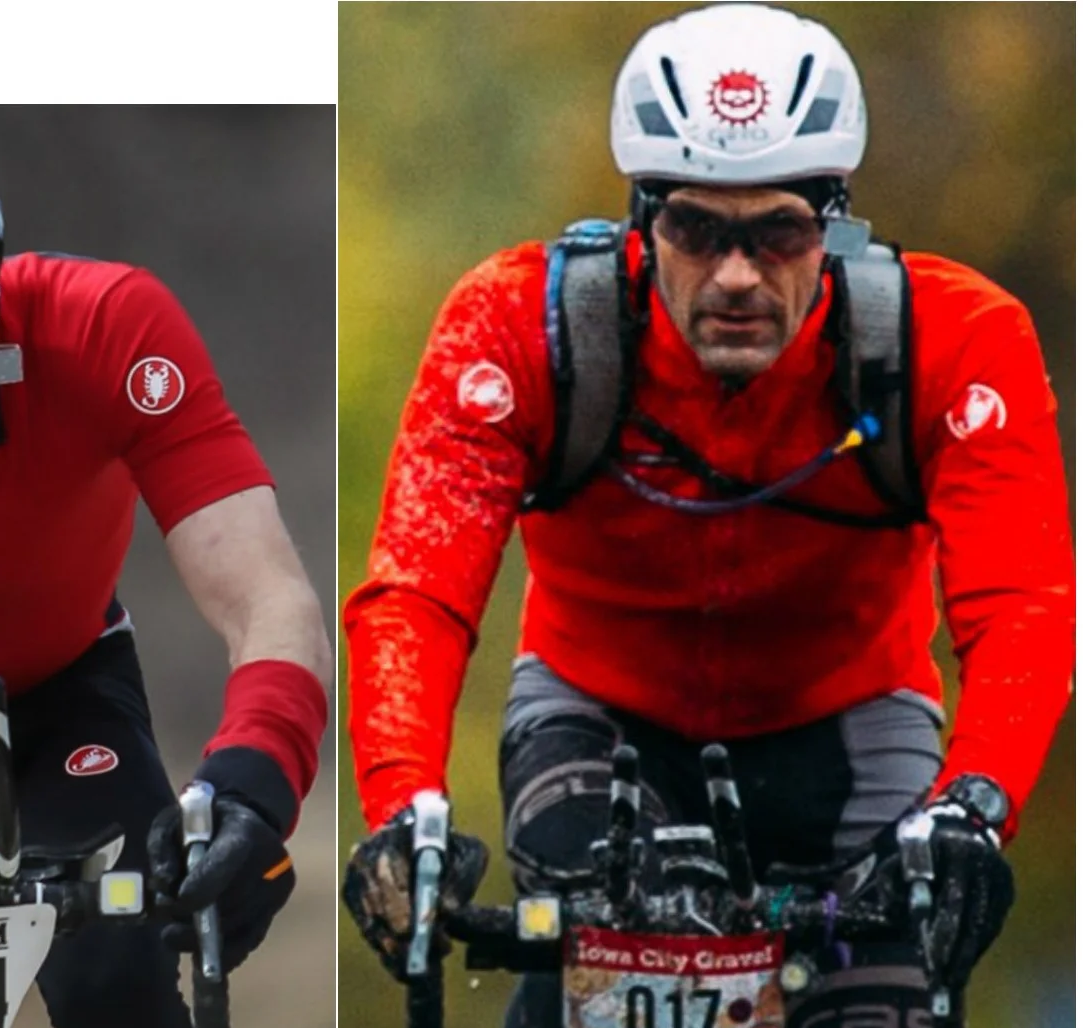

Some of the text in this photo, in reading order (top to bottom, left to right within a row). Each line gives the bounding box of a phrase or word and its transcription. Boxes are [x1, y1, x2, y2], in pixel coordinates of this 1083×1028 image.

[577, 941, 774, 973] Iowa City Gravel
